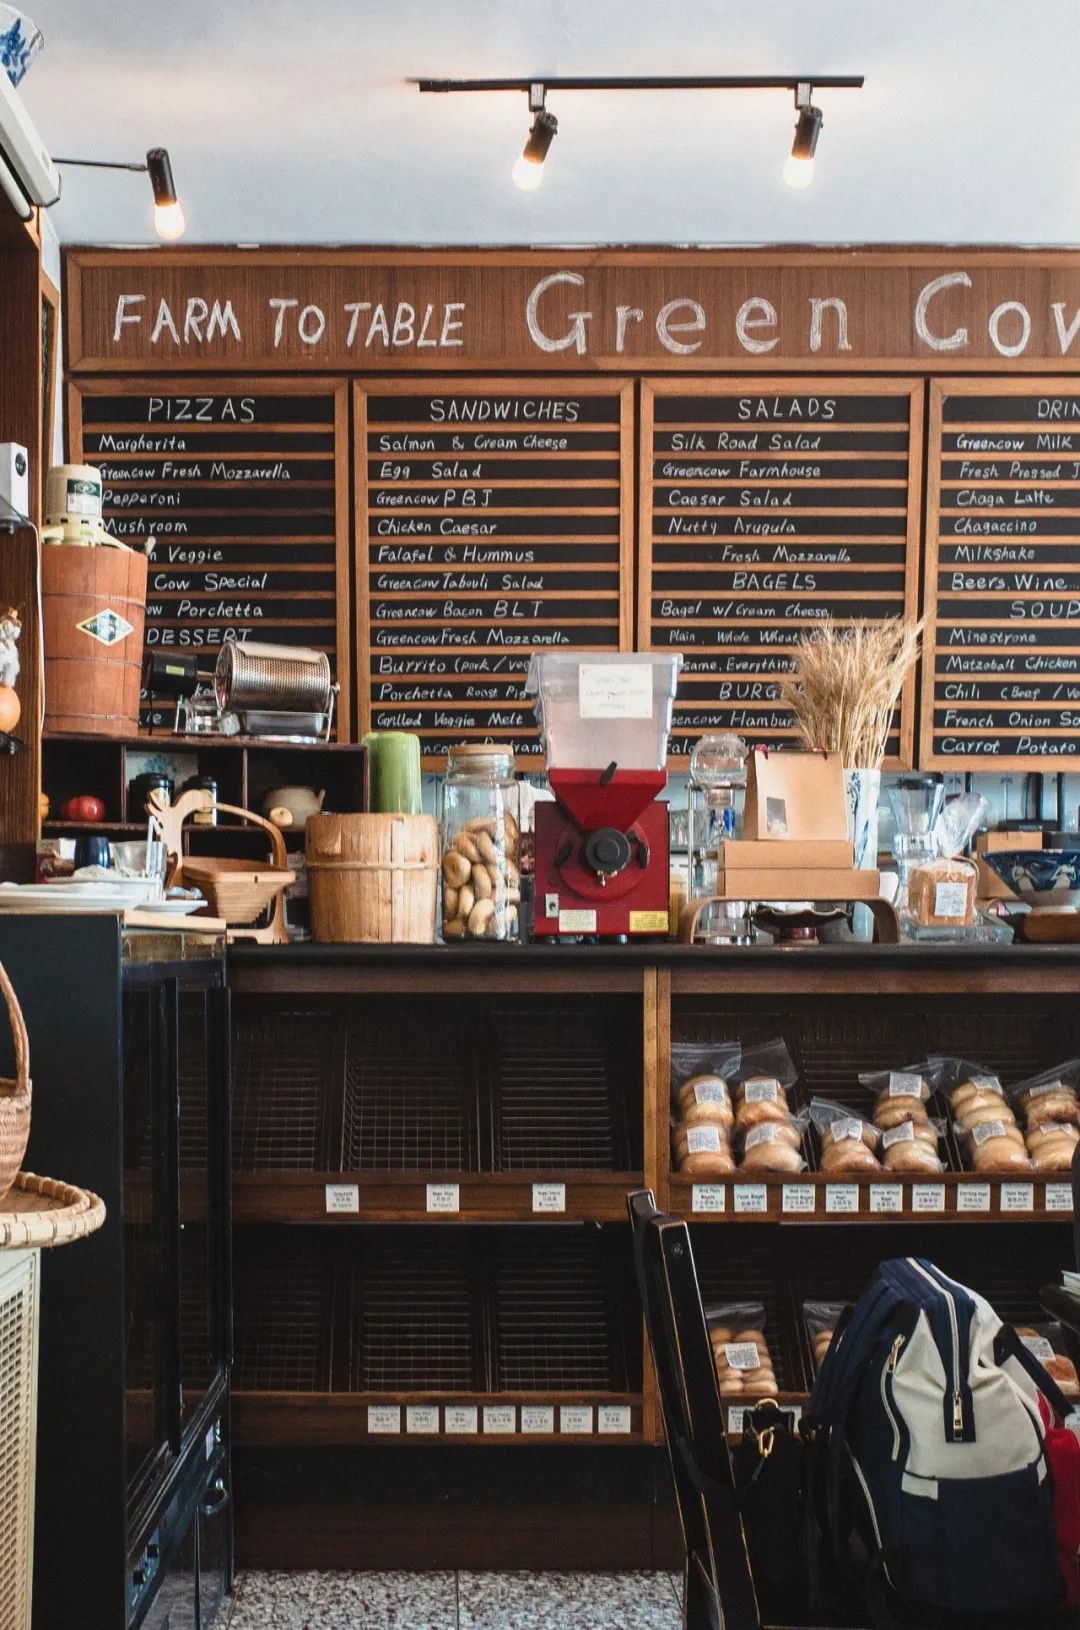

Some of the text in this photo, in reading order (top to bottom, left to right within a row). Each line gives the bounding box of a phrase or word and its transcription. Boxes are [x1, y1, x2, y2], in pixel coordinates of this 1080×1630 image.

[113, 294, 466, 348] FARM TO TABLE
[526, 271, 853, 354] Green
[430, 399, 580, 422] SANDWICHES
[738, 398, 836, 420] SALADS
[98, 434, 187, 452] Margherita
[379, 435, 568, 452] Salmon & Cream Cheese
[671, 432, 821, 451] Silk Road Salad
[957, 434, 1025, 451] Greencow
[162, 462, 202, 479] Fresh
[210, 462, 291, 481] Mozzarella
[380, 461, 482, 480] Egg Salad
[739, 461, 822, 478] Farmhouse
[960, 461, 999, 479] Fresh
[1010, 461, 1061, 479] Pressed
[102, 489, 181, 507] Pepperoni
[376, 492, 439, 507] Greencow
[668, 490, 792, 507] Caesar Salad
[957, 489, 1054, 508] Chaga Latte
[102, 517, 188, 535] Mushroom
[377, 518, 498, 536] Chicken Caesar
[668, 517, 796, 535] Nutty Arugula
[954, 517, 1037, 535] Chagaccino
[168, 546, 223, 565] Veggie
[378, 545, 433, 563] Falafel
[462, 545, 534, 562] Hummus
[721, 545, 851, 563] Fresh Mozzarella
[954, 544, 1035, 563] Milkshake
[154, 572, 268, 592] Cow Special
[377, 572, 543, 590] Greencow Tabouli Salad
[732, 572, 817, 591] BAGELS
[177, 600, 264, 618] Porchetta
[443, 601, 483, 617] Bacon
[660, 600, 702, 616] Bagel
[735, 604, 776, 617] Cream
[785, 602, 829, 617] Cheese
[146, 628, 253, 647] DESSERT
[376, 628, 571, 645] Greencow Fresh Mozzarella
[717, 630, 750, 643] Whole
[949, 627, 1037, 646] Minestrone
[379, 656, 446, 675] Burrito
[682, 657, 796, 673] same, Everything
[945, 655, 1077, 673] Matzoball Chicken
[379, 682, 452, 700] Porchetta
[466, 686, 498, 699] Roast
[944, 684, 980, 700] Chili
[377, 711, 524, 728] Grilled Veggie Melt
[944, 710, 994, 728] French
[1008, 711, 1051, 727] Onion
[941, 735, 1076, 755] Carrot Potato
